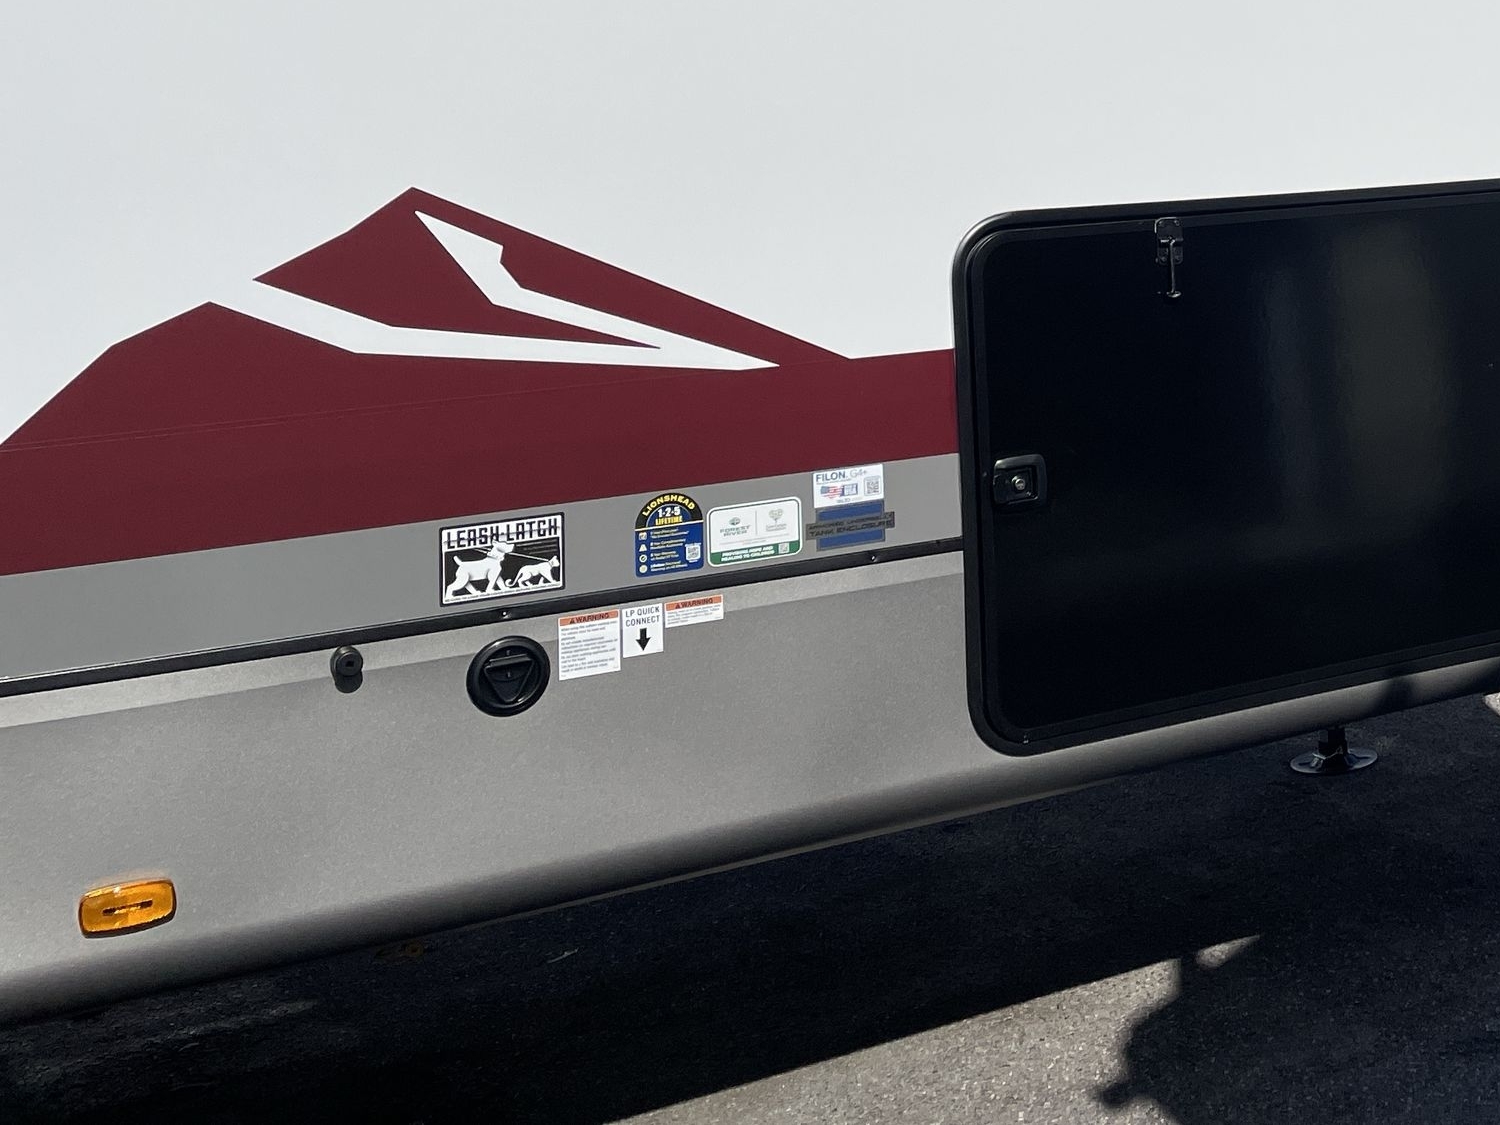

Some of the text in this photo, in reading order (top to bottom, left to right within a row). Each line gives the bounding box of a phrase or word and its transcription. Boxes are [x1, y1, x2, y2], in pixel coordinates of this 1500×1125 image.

[816, 472, 846, 482] FILON
[642, 495, 695, 516] LIONSHEAD
[681, 598, 713, 608] WARNING
[625, 609, 635, 618] LP
[637, 606, 660, 616] QUICK
[576, 613, 609, 623] WARNING
[626, 615, 660, 627] CONNECT
